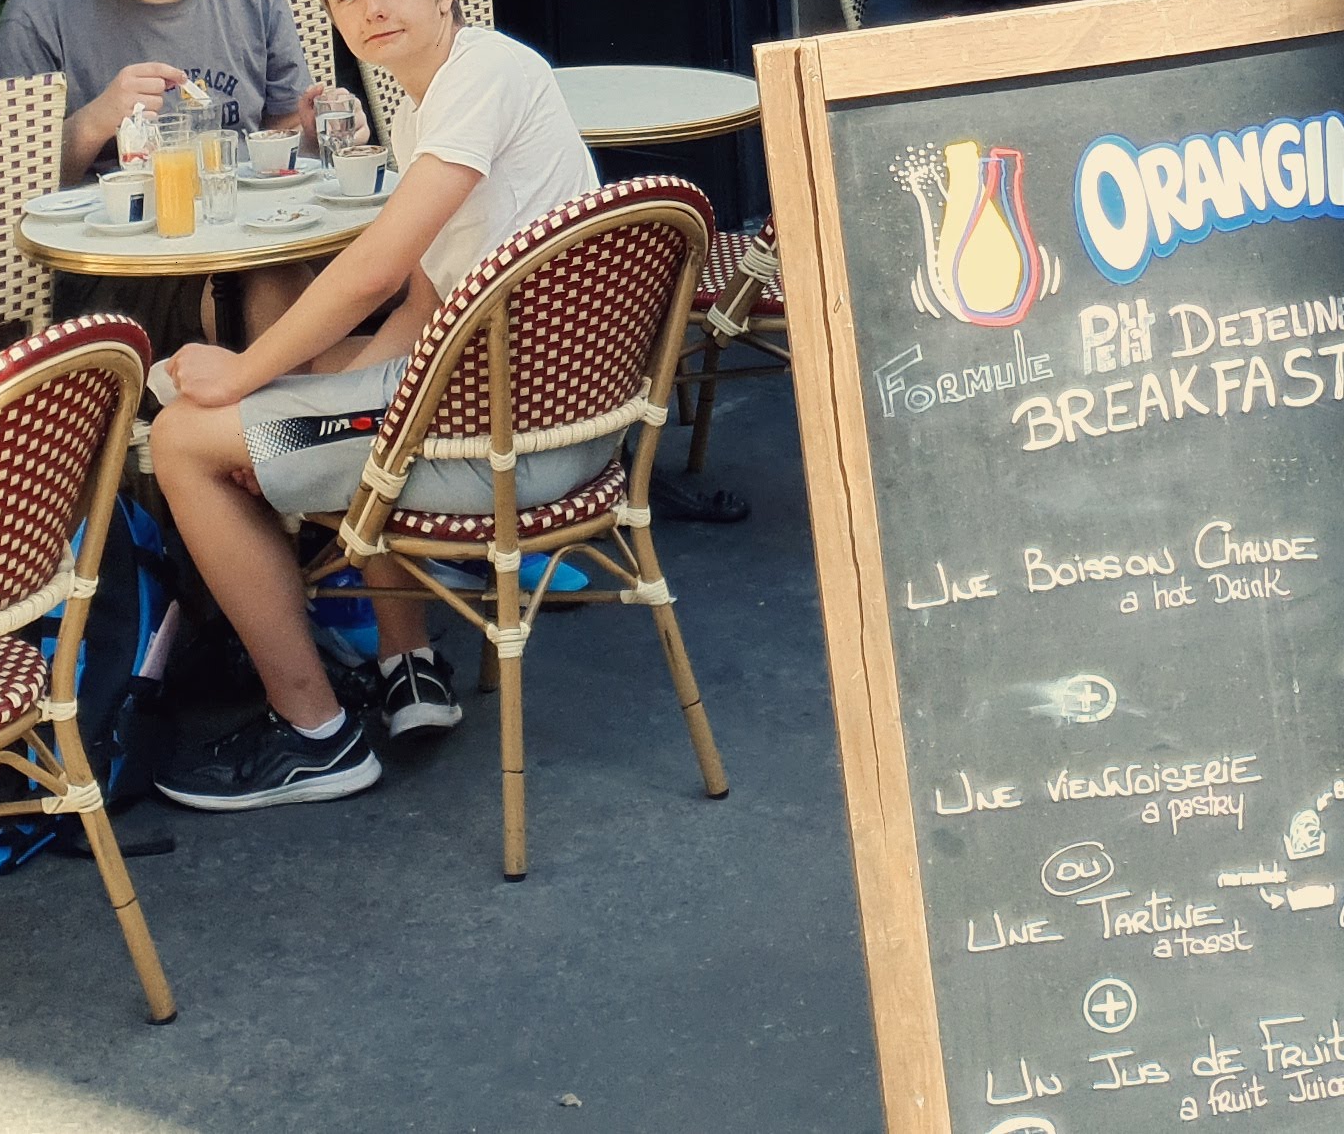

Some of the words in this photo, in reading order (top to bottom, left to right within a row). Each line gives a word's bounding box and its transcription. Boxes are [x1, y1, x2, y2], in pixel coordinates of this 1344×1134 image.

[184, 68, 239, 96] EACH
[1119, 588, 1140, 614] a
[1153, 574, 1207, 608] hot
[1141, 799, 1161, 825] a
[1167, 790, 1247, 837] pastry
[1152, 934, 1172, 958] a
[1179, 1095, 1201, 1123] a
